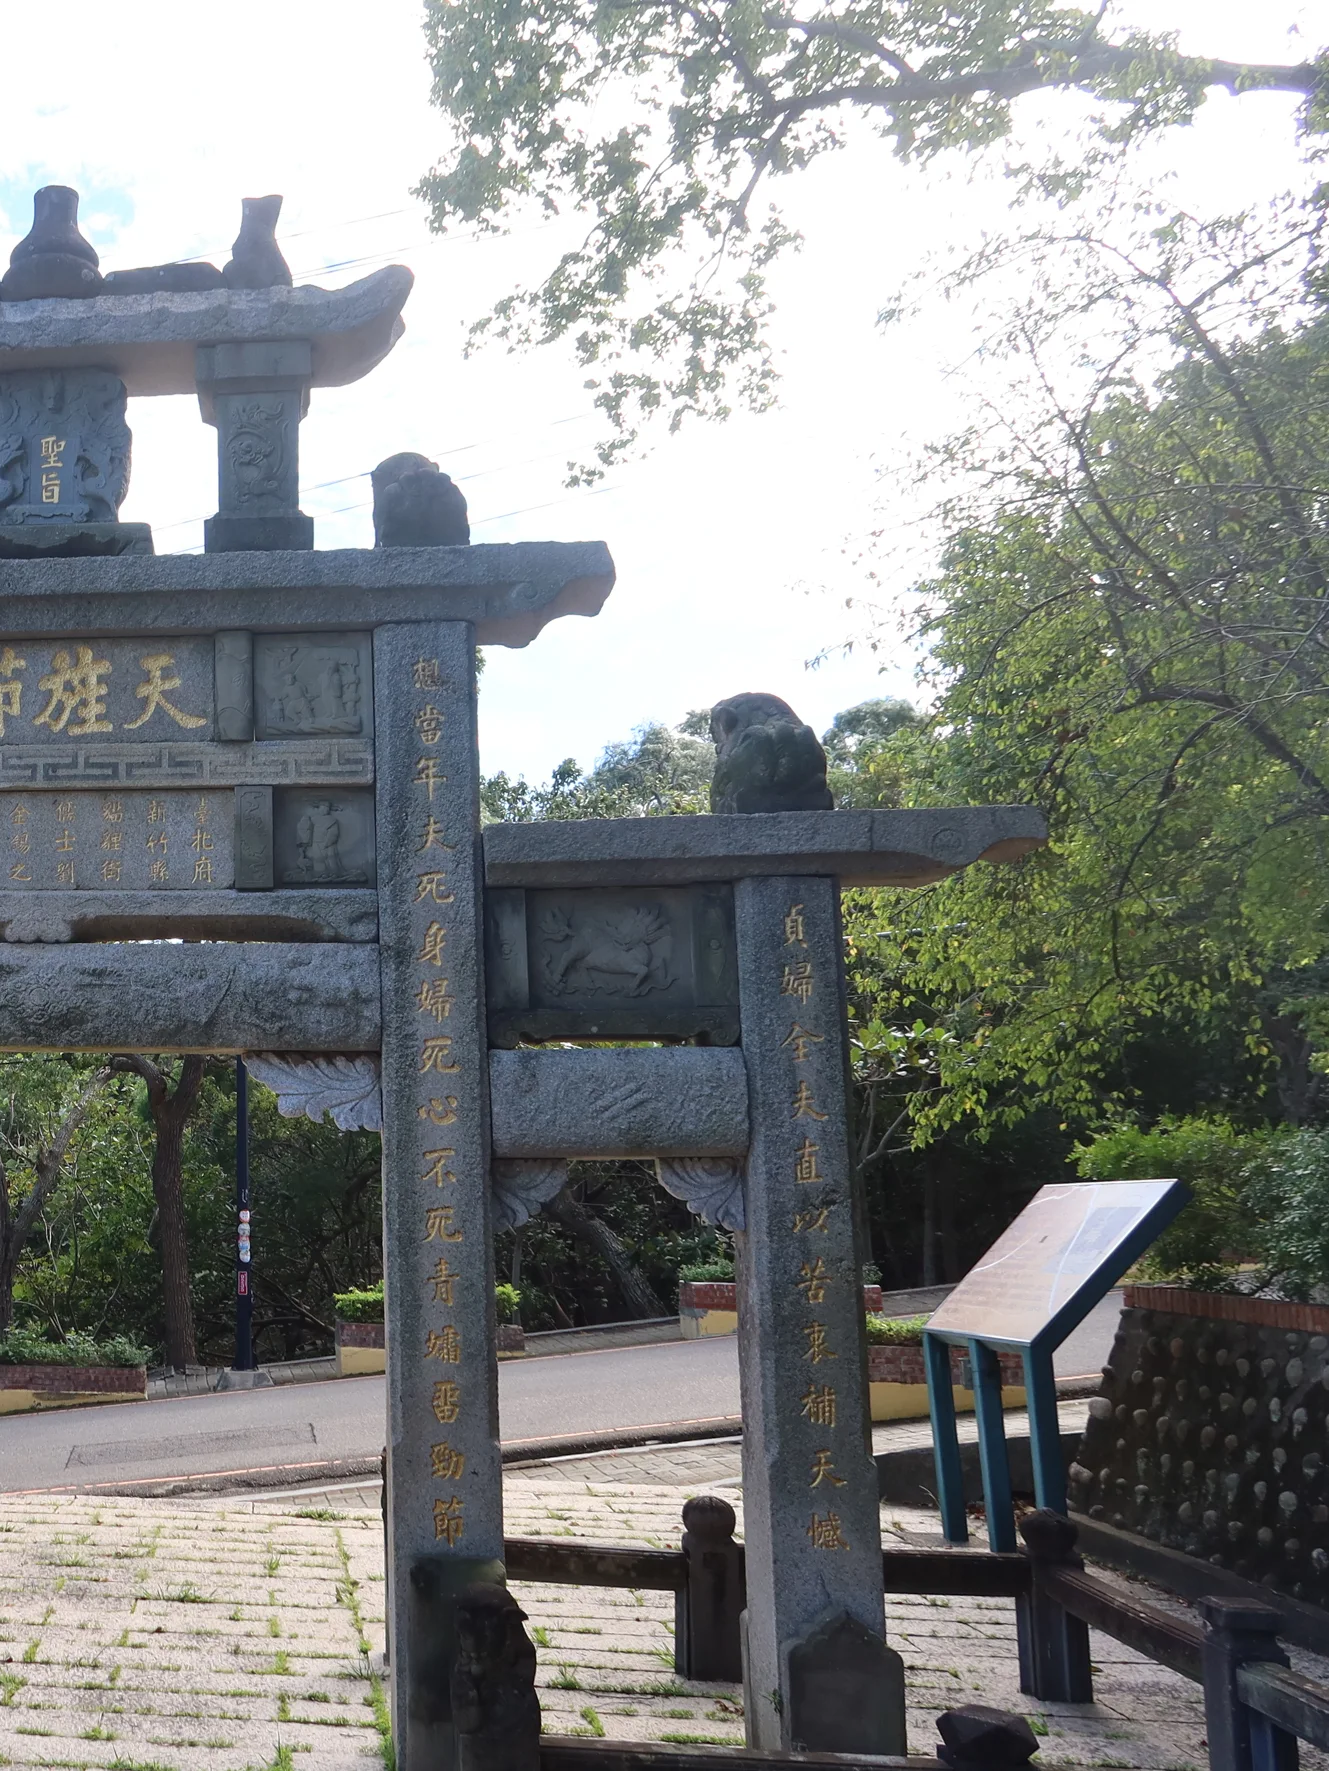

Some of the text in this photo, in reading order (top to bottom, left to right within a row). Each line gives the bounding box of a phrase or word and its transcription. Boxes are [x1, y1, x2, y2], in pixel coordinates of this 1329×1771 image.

[40, 435, 66, 503] 聖旨
[9, 802, 32, 881] 金錫之
[146, 801, 169, 881] 新竹縣
[191, 797, 214, 884] 臺北府
